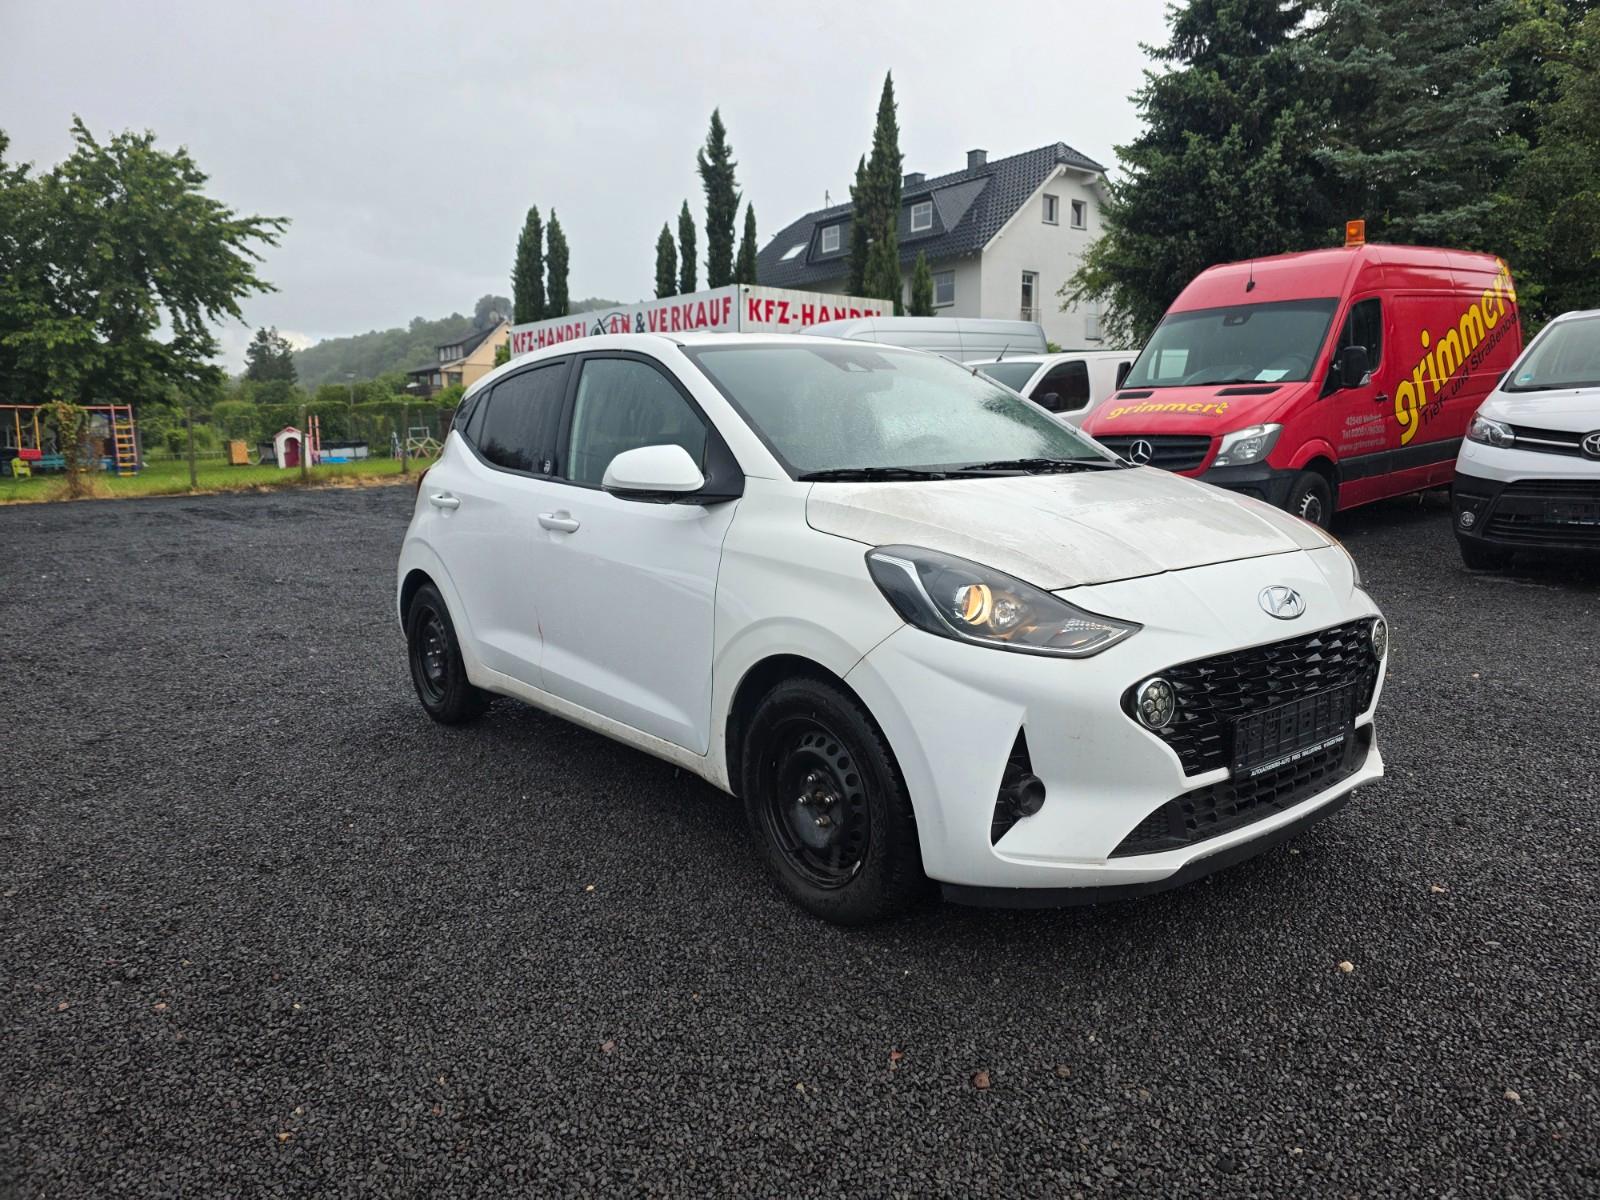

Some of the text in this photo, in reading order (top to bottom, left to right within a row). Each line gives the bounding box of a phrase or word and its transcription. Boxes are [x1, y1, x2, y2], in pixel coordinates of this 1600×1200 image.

[610, 314, 630, 334] AN
[635, 312, 645, 333] &
[647, 296, 732, 332] VERKAUF
[1395, 257, 1517, 446] grimmert
[1451, 365, 1469, 395] und
[1470, 312, 1517, 371] Straßenba
[1105, 402, 1229, 420] grimmert
